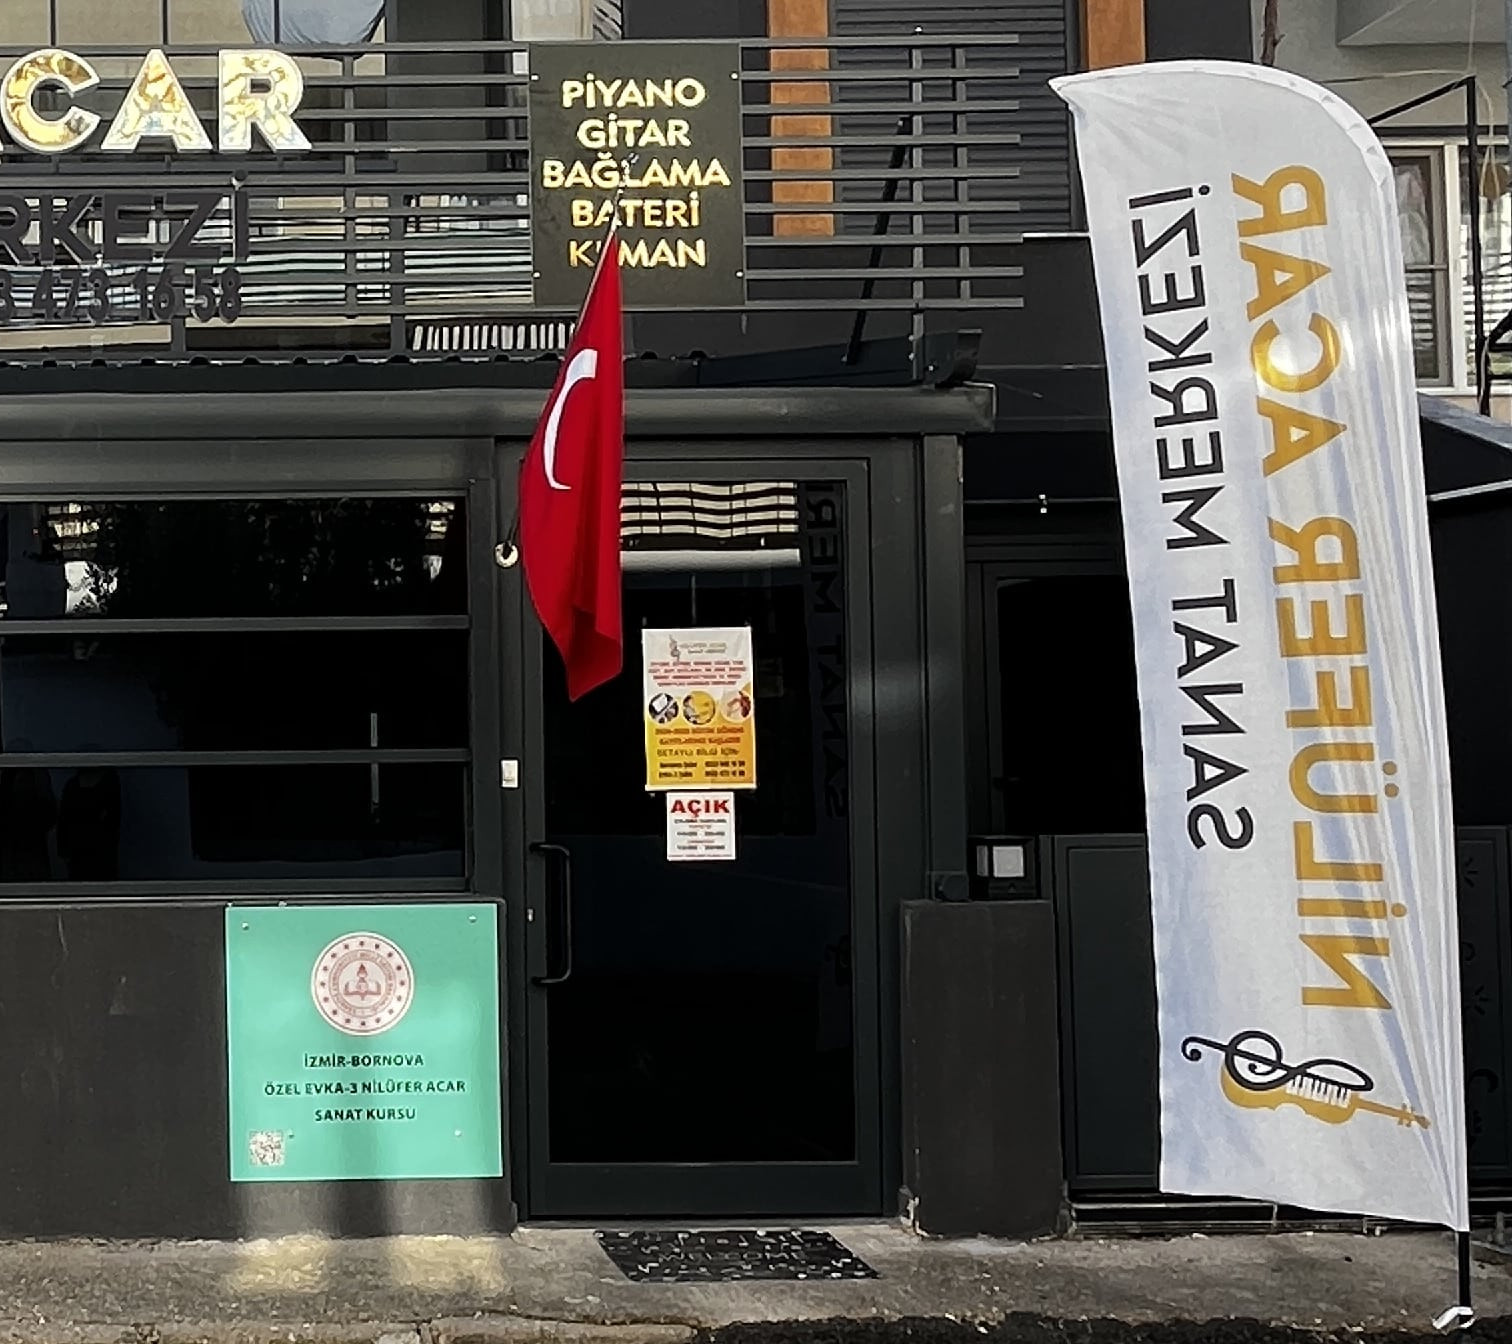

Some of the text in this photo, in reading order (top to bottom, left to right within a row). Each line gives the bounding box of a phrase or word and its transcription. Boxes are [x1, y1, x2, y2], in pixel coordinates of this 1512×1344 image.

[561, 72, 707, 108] PİYANO
[576, 112, 691, 149] GİTAR
[571, 190, 701, 228] BATERİ
[568, 238, 707, 268] KMAN
[31, 267, 111, 324] 473
[192, 265, 242, 324] 58
[670, 799, 730, 817] AÇIK
[304, 1052, 425, 1068] İZMİR-BORNOVA
[264, 1078, 466, 1096] ÖZEL EVKA-3 NİLÜFER ACAR
[314, 1106, 417, 1122] SANAT KURSU
